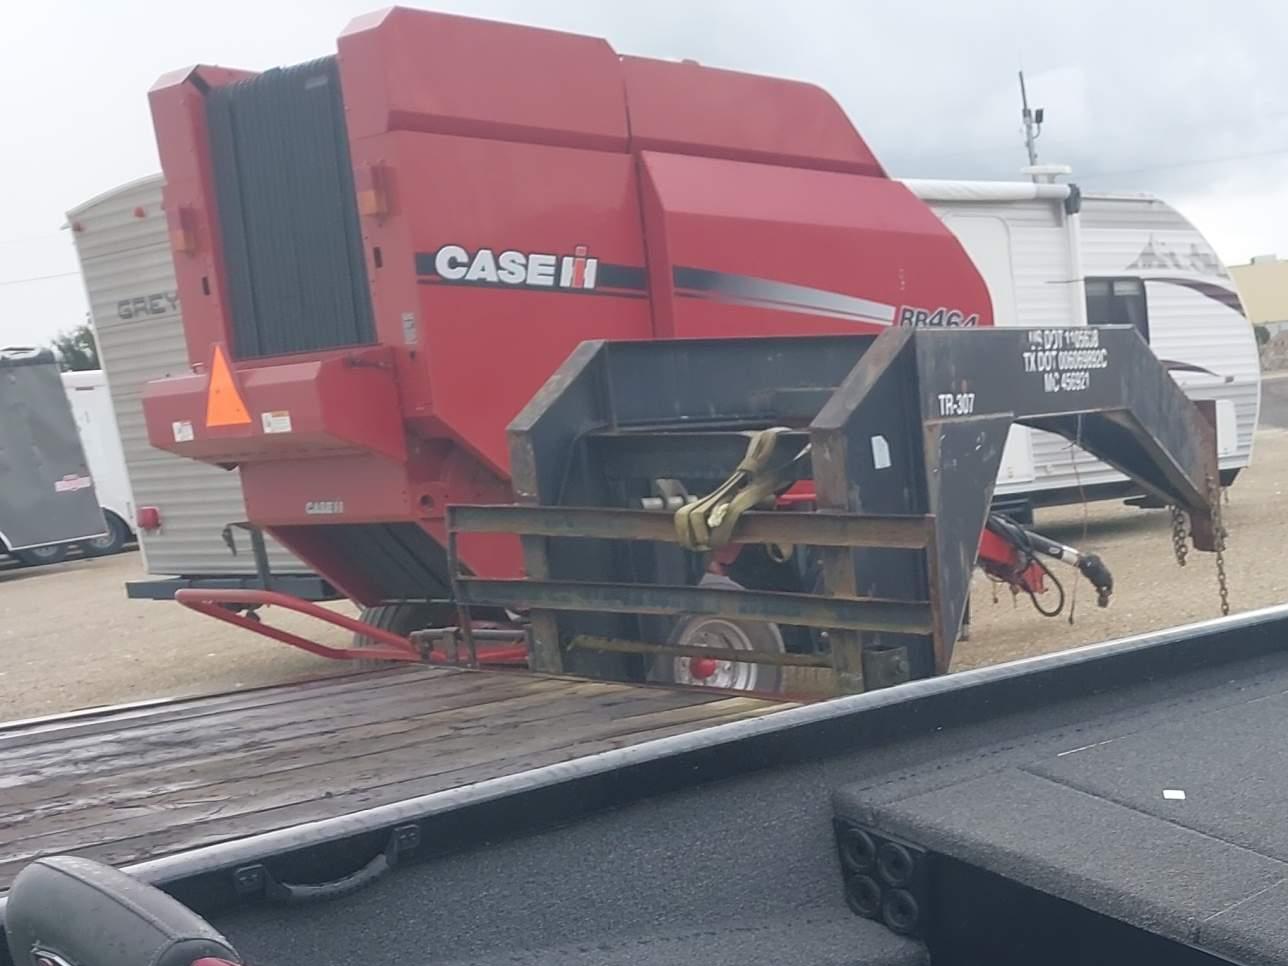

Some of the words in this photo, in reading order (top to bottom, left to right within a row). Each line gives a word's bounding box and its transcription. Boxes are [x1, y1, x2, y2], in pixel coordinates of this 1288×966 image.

[435, 245, 556, 286] CASE
[1044, 329, 1063, 349] DOT
[1022, 352, 1036, 372] TX
[1037, 350, 1057, 371] DOT
[1044, 372, 1060, 392] MC
[938, 393, 976, 416] TR-307
